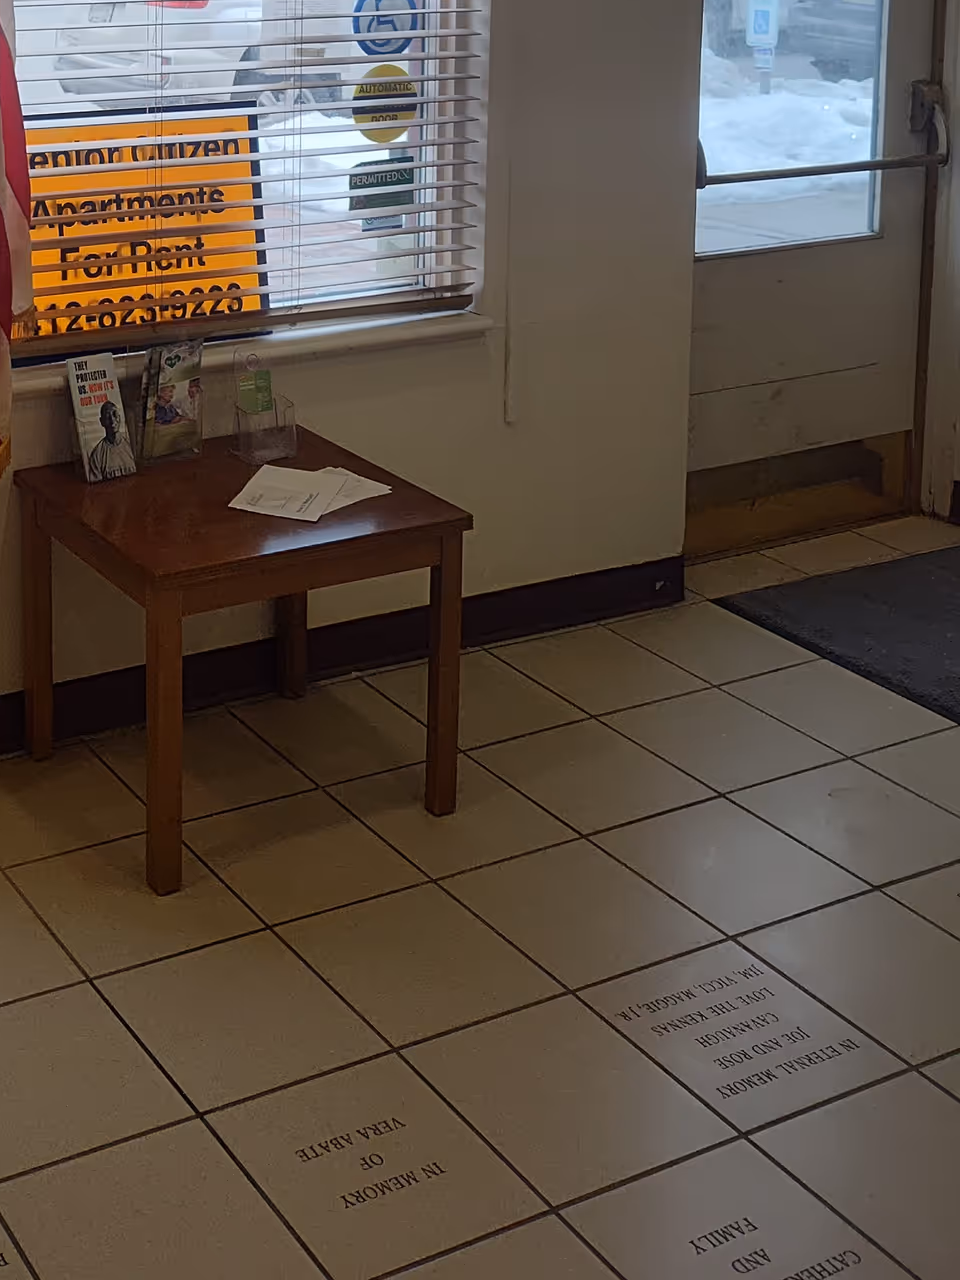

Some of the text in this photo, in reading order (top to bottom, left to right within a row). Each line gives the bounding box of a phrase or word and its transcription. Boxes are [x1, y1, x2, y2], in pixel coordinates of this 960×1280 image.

[358, 82, 413, 94] AUTOMATIC
[371, 114, 399, 123] DOOR
[28, 134, 240, 170] enior Citizen
[351, 171, 398, 186] PERMITTED
[29, 187, 227, 237] Apartments
[60, 237, 207, 281] For Rent
[74, 360, 88, 371] THEY
[75, 370, 107, 383] PROTECTED
[78, 384, 88, 395] US.
[692, 975, 739, 995] VICCI,
[732, 963, 765, 980] JIM,
[636, 987, 698, 1014] MAGGIE,
[651, 986, 775, 1037] LOVE THE KENNAS
[694, 1012, 779, 1048] CAVANAUGH
[713, 1025, 811, 1071] JOE AND ROSE
[715, 1038, 861, 1100] IN ETERNAL MEMORY
[294, 1118, 407, 1163] VERA ABATE
[360, 1152, 385, 1170] OF
[338, 1161, 447, 1210] IN MEMORY
[687, 1216, 759, 1256] FAMILY
[731, 1248, 772, 1274] AND
